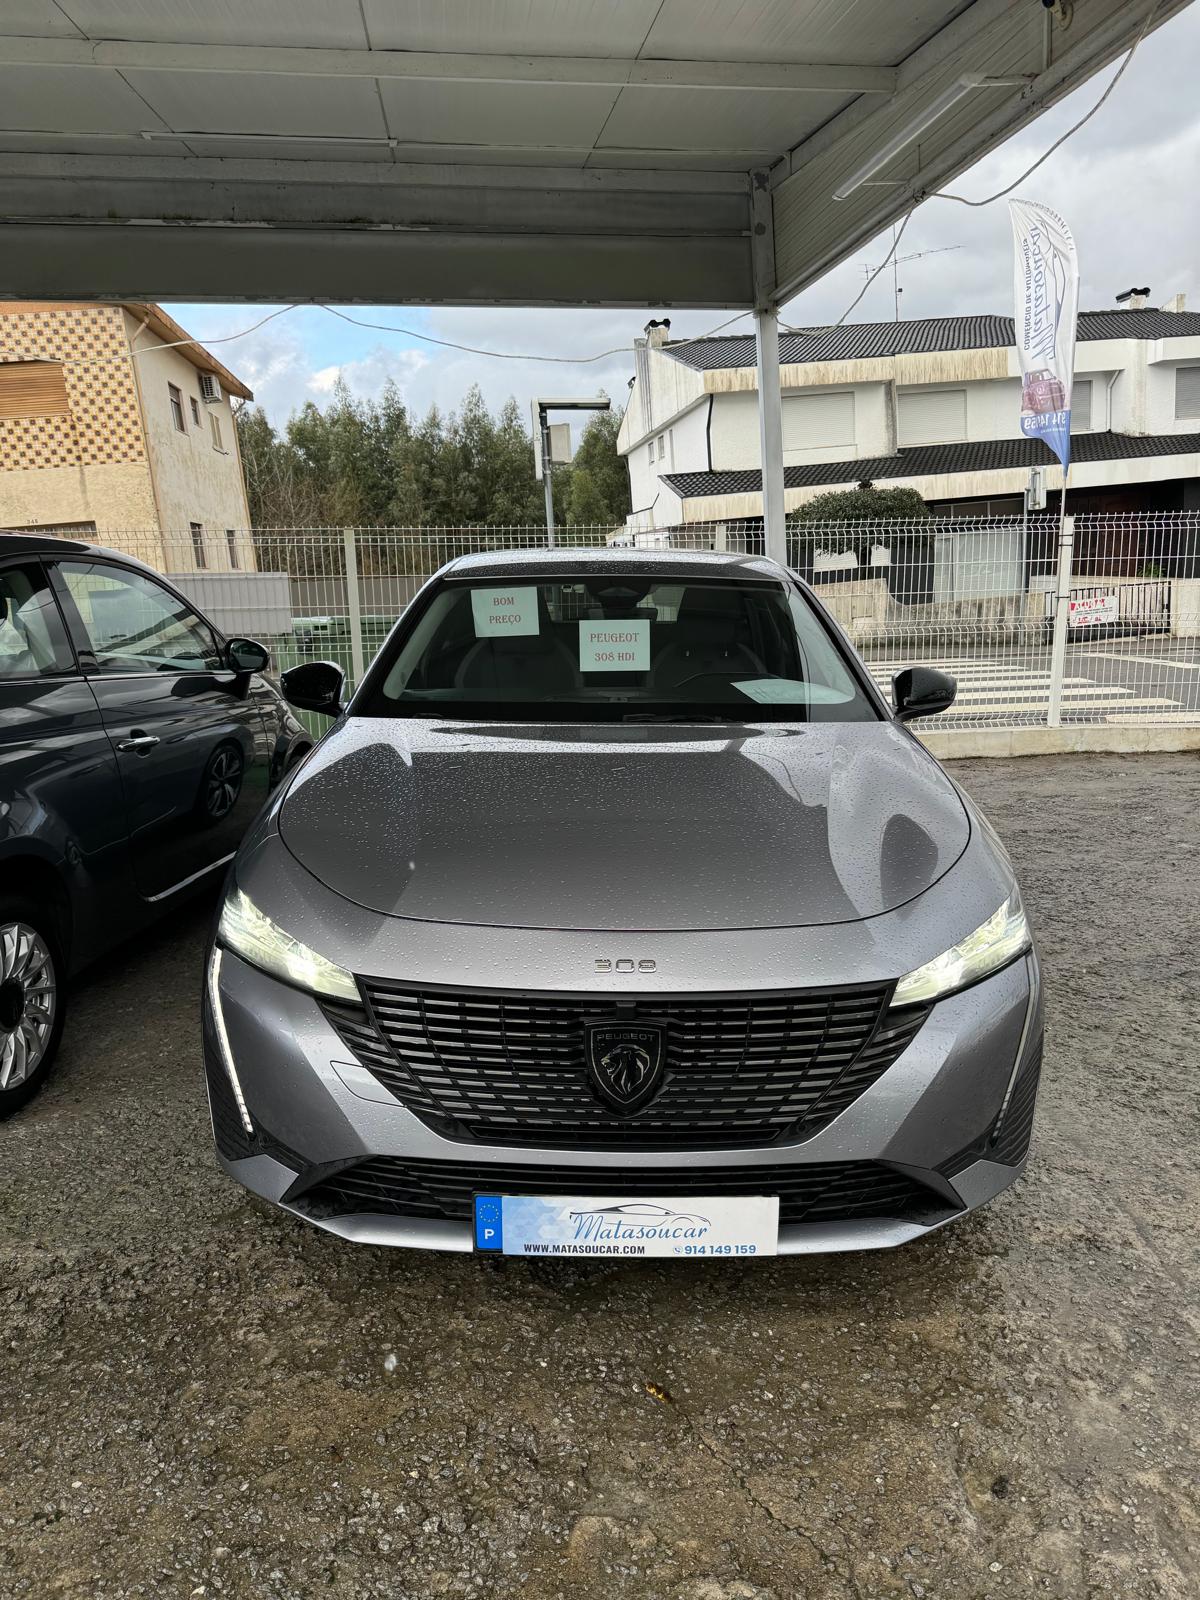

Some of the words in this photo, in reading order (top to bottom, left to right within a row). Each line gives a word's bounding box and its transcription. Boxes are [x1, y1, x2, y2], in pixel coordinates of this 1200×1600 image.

[493, 597, 515, 606] BOM
[489, 614, 521, 626] PREÇO
[590, 632, 640, 643] PEUGEOT
[594, 652, 615, 662] 308
[594, 959, 657, 974] 308
[596, 1032, 656, 1042] PEUGEOT
[570, 1213, 708, 1243] Matasoucar
[484, 1228, 495, 1240] P
[523, 1244, 646, 1255] WWW.MATASOUCAR.COM
[684, 1245, 706, 1255] 914
[709, 1245, 732, 1255] 149
[735, 1244, 757, 1254] 159
